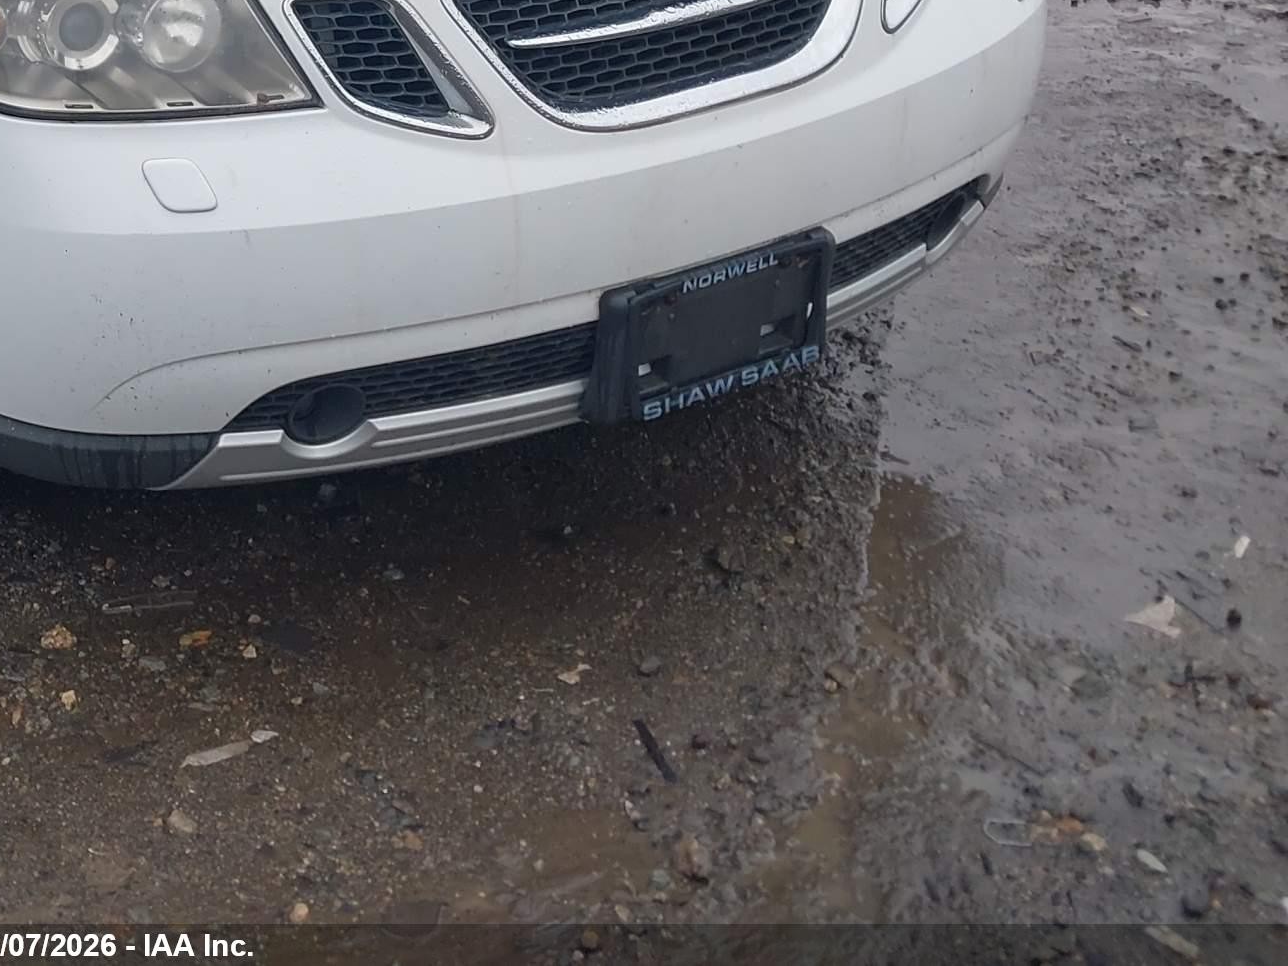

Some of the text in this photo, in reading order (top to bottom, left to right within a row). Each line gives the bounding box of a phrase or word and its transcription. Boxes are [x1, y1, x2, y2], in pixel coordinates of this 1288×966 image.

[682, 252, 779, 293] NORWELL
[643, 345, 820, 421] SHAW SAAB
